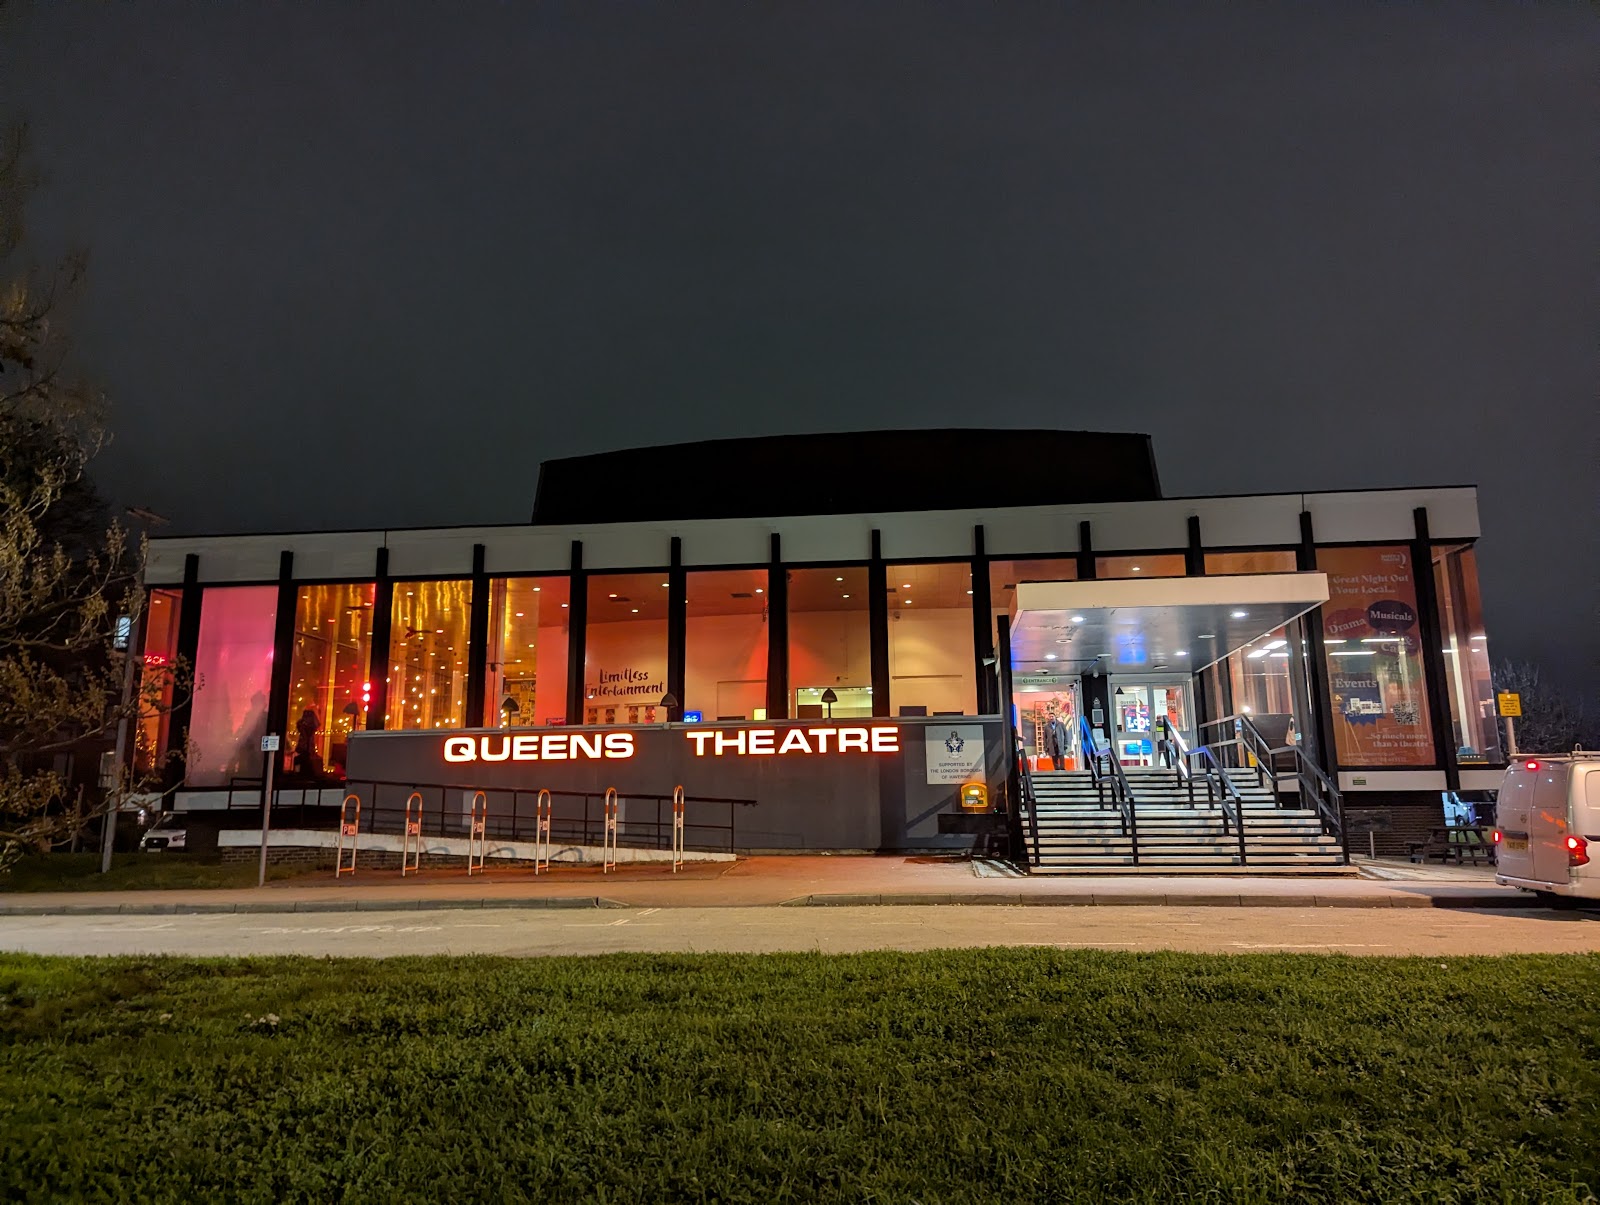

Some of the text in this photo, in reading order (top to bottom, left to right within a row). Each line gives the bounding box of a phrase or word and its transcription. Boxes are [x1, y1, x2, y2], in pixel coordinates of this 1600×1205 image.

[1361, 574, 1388, 585] Night
[1390, 574, 1409, 582] Out
[1336, 586, 1359, 594] Your
[1370, 610, 1413, 621] Musicals
[1328, 618, 1367, 634] Drama
[600, 668, 649, 684] Limitless
[1335, 678, 1378, 688] Events
[585, 681, 665, 700] Entertainment
[444, 727, 900, 763] QUEENS THEATRE
